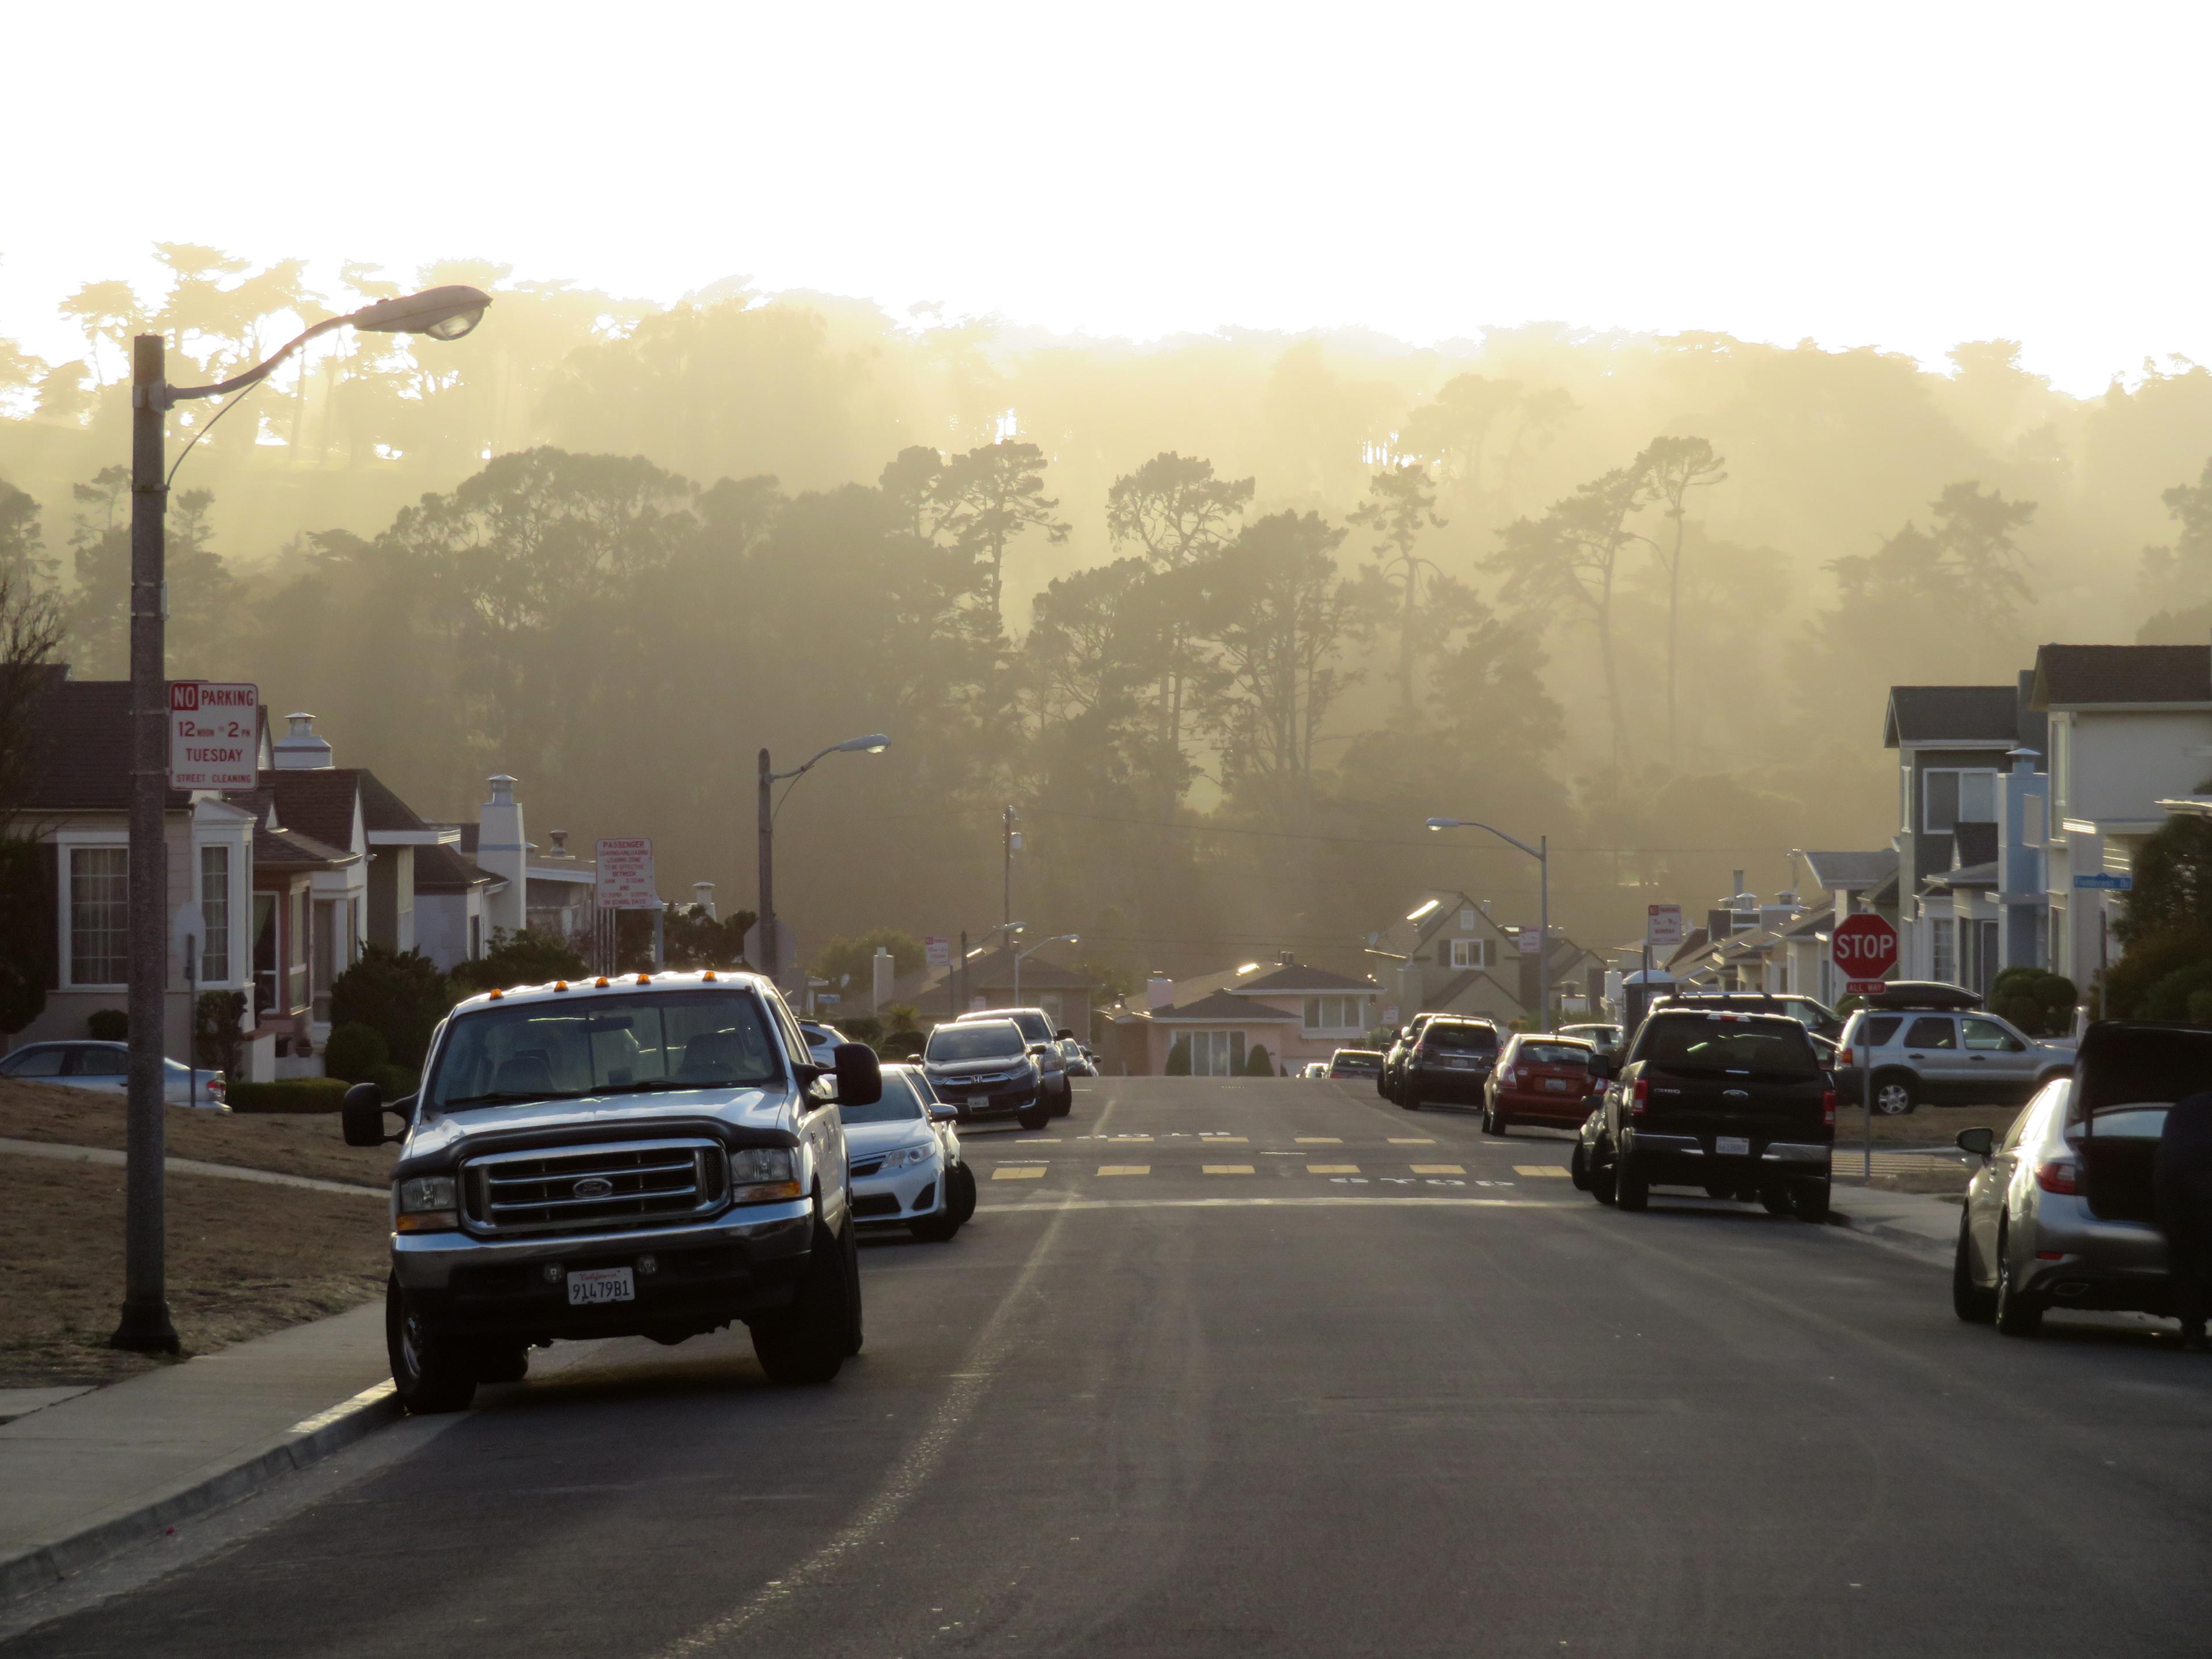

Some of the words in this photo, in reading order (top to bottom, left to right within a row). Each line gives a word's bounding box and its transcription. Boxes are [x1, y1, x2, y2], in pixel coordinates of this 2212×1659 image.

[174, 686, 195, 708] NO
[202, 690, 253, 706] PARKING
[179, 721, 195, 737] 12
[228, 721, 239, 737] 2
[242, 729, 251, 737] PM
[186, 748, 243, 762] TUESDAY
[176, 774, 205, 783] STREET
[212, 774, 251, 783] CLEANING
[603, 840, 645, 849] PASSENGER
[1836, 934, 1893, 959] STOP
[1849, 984, 1863, 992] ALL
[581, 1272, 618, 1281] California
[573, 1279, 630, 1300] 91479B1
